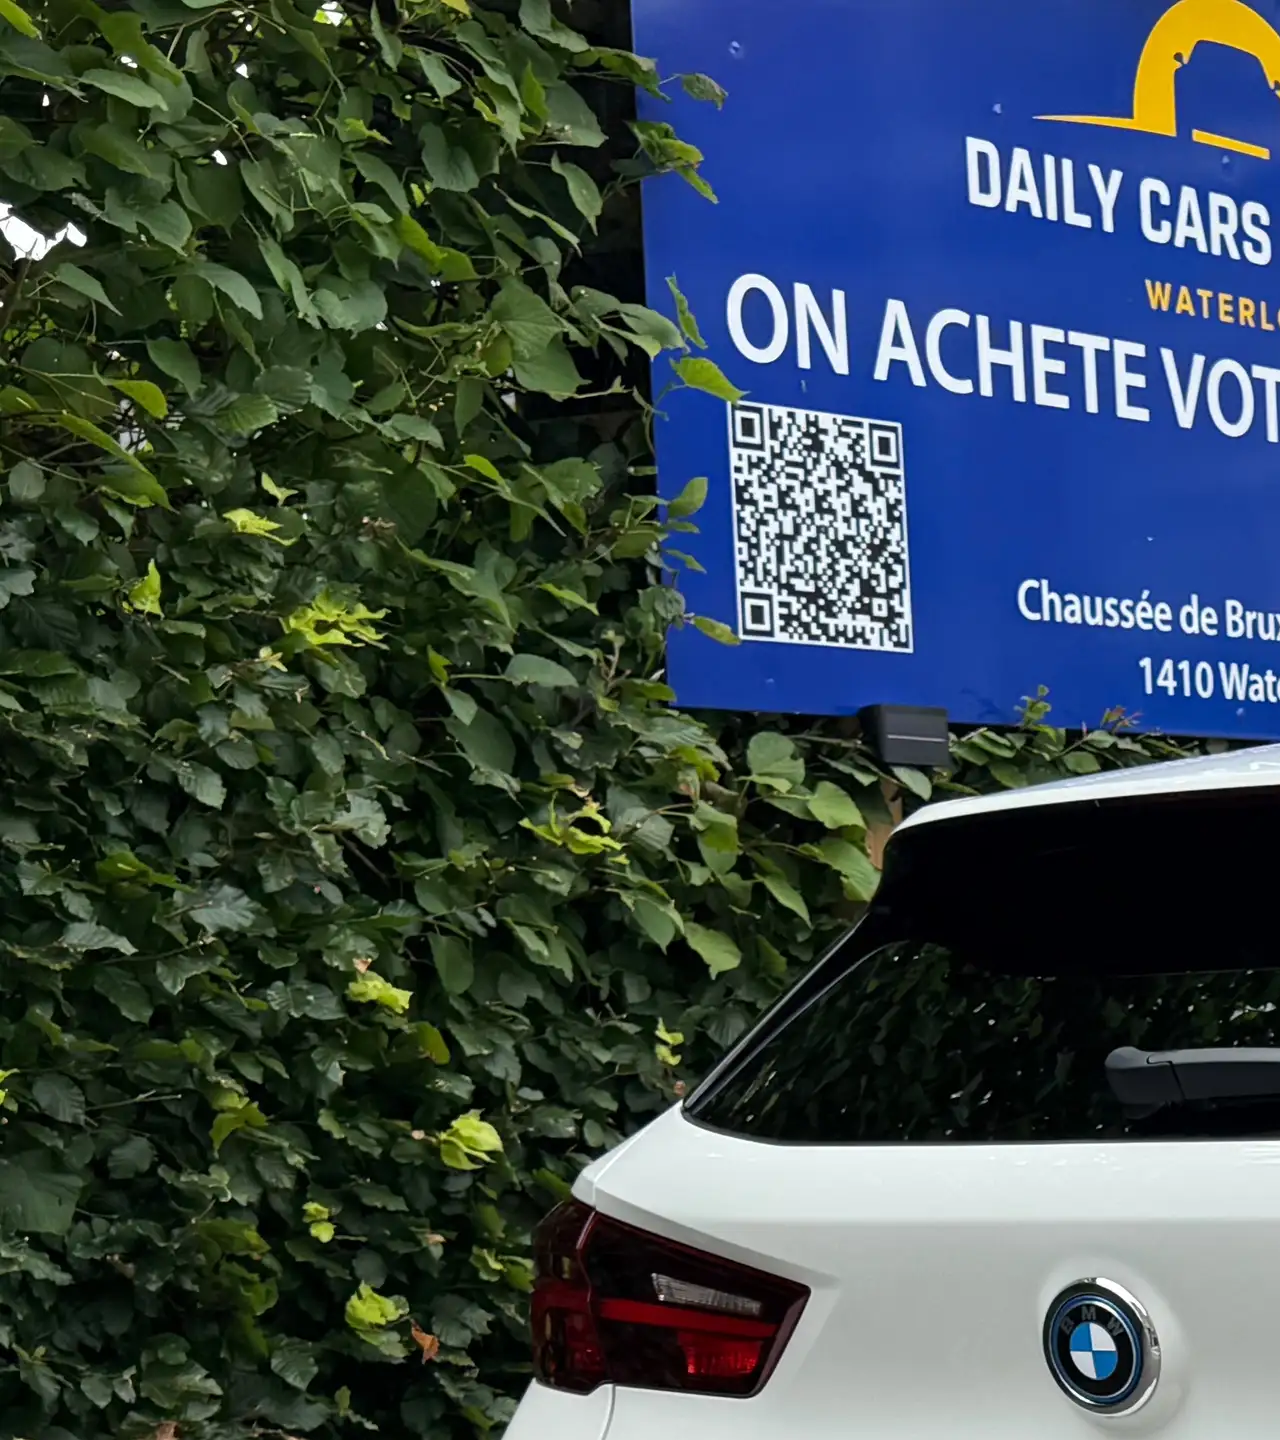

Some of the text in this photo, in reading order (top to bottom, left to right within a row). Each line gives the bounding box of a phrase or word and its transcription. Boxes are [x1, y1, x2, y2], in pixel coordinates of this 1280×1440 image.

[965, 136, 1123, 233] DAILY
[1140, 177, 1272, 266] CARS
[726, 273, 849, 375] ON
[872, 297, 1150, 422] ACHETE
[1017, 578, 1172, 632] Chaussée
[1180, 594, 1217, 636] de
[1138, 657, 1214, 699] 1410
[1060, 1305, 1125, 1337] BMW
